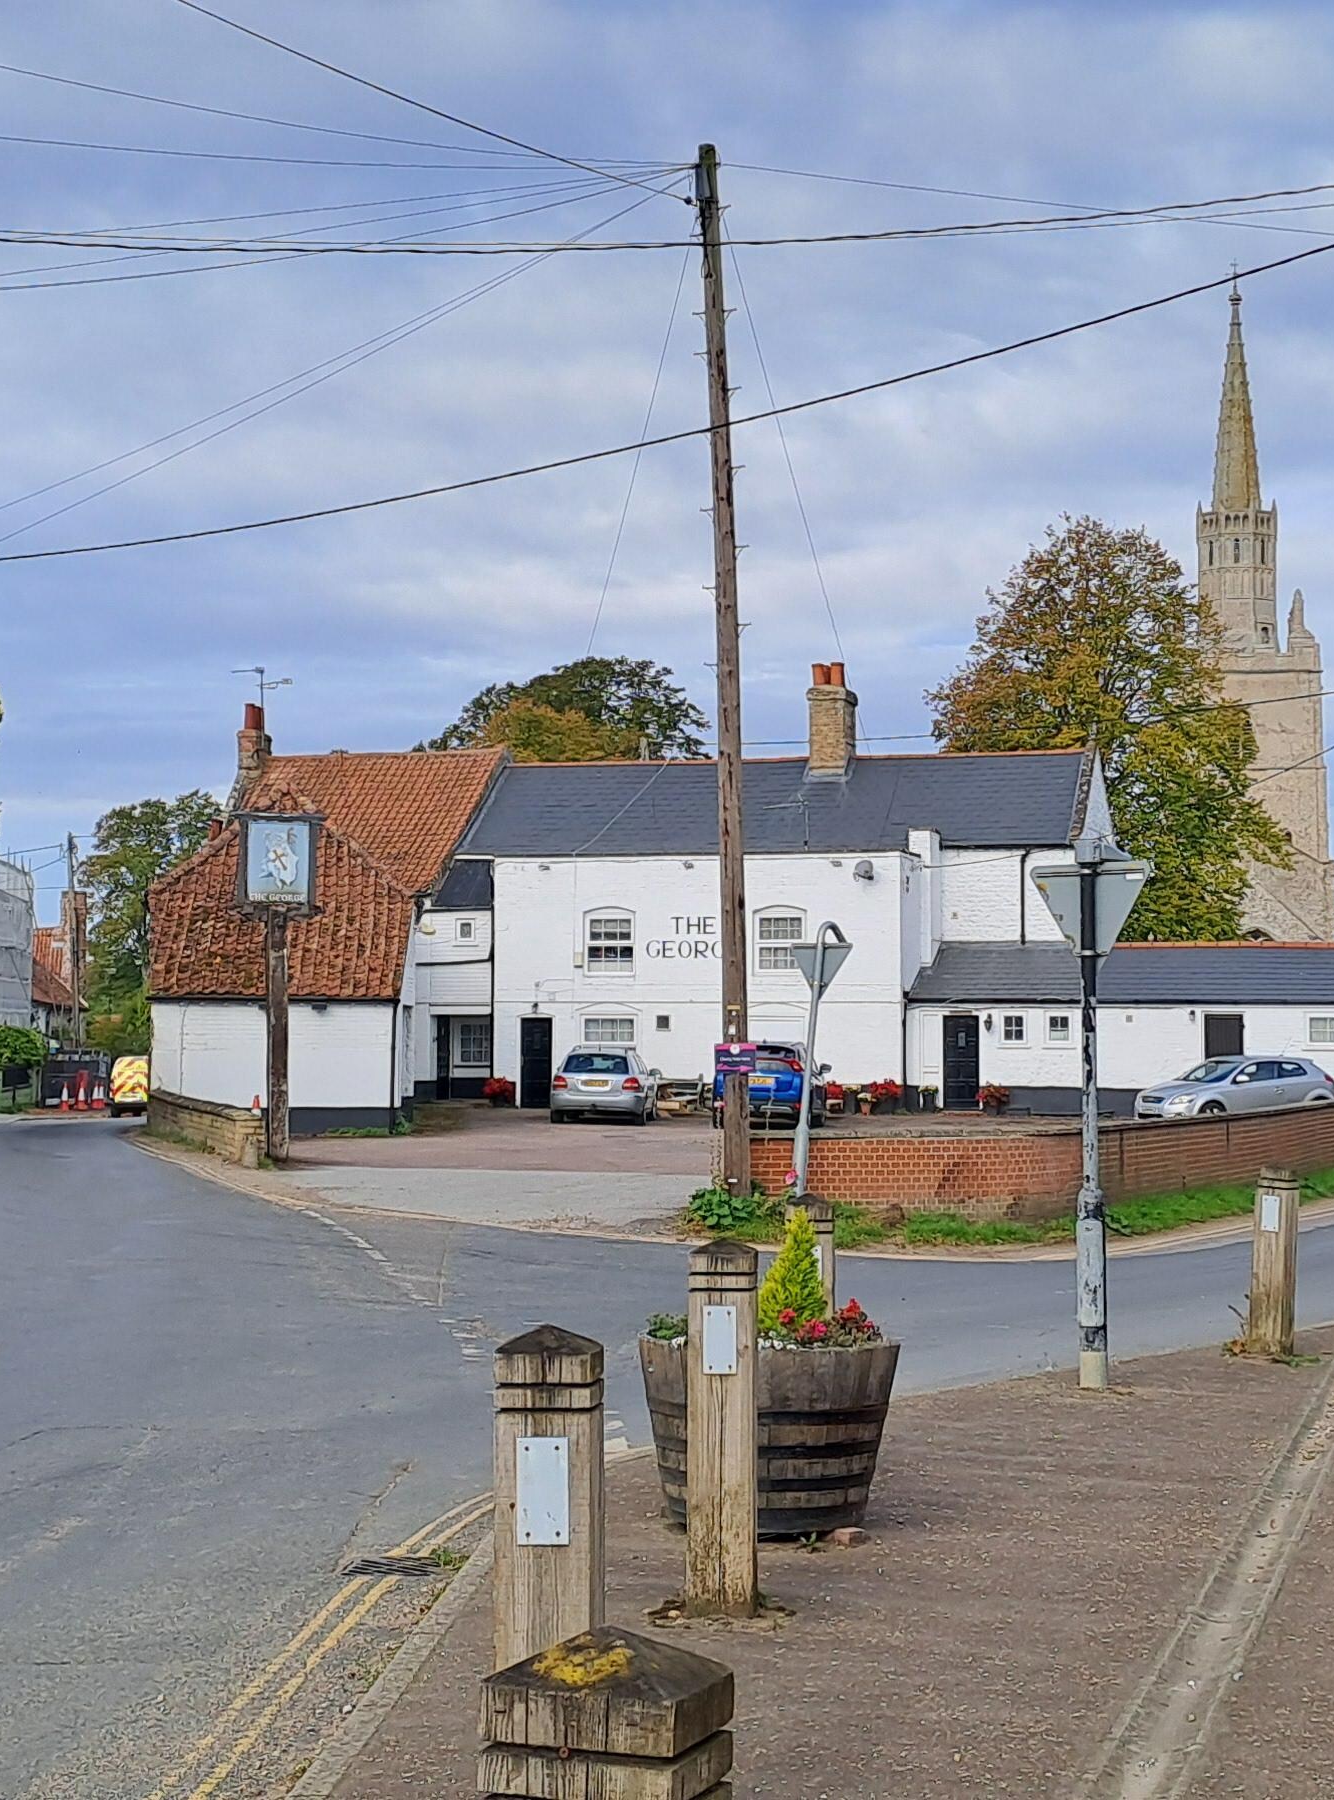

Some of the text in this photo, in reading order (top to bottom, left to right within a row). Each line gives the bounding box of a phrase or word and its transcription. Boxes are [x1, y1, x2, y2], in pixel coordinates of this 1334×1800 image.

[249, 893, 306, 902] THE GEORGE
[670, 916, 717, 935] THE
[645, 940, 723, 959] GEORG
